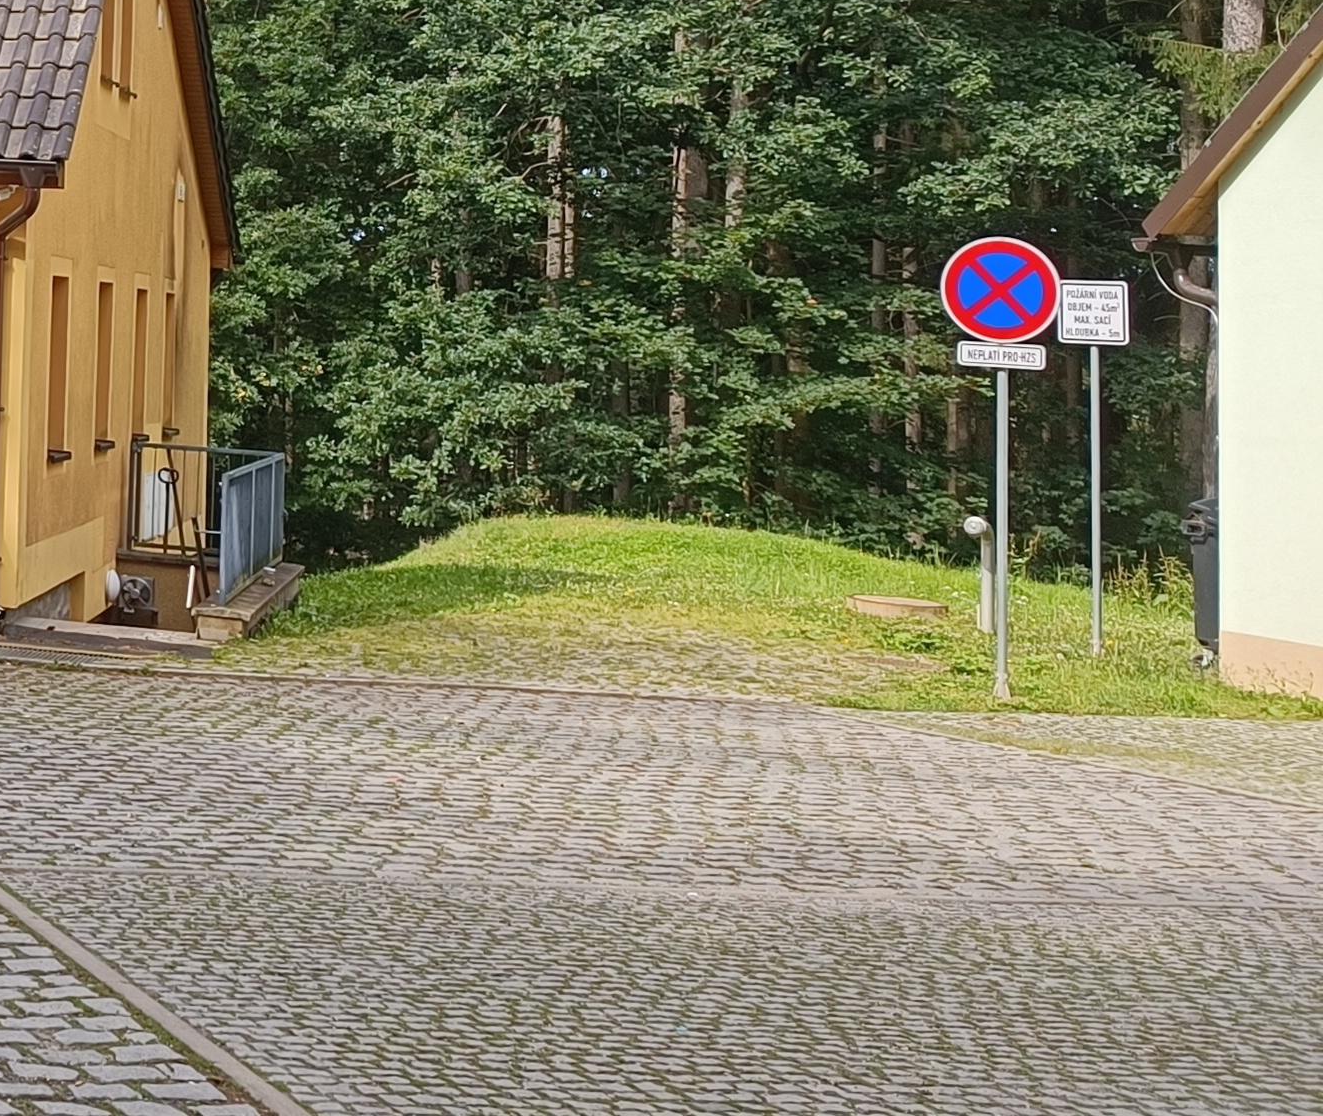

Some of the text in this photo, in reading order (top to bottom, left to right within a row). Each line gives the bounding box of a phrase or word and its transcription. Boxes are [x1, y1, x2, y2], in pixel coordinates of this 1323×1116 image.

[1099, 291, 1119, 300] VODA
[1067, 302, 1092, 312] OBJEM
[1065, 327, 1099, 337] HLOUBKA
